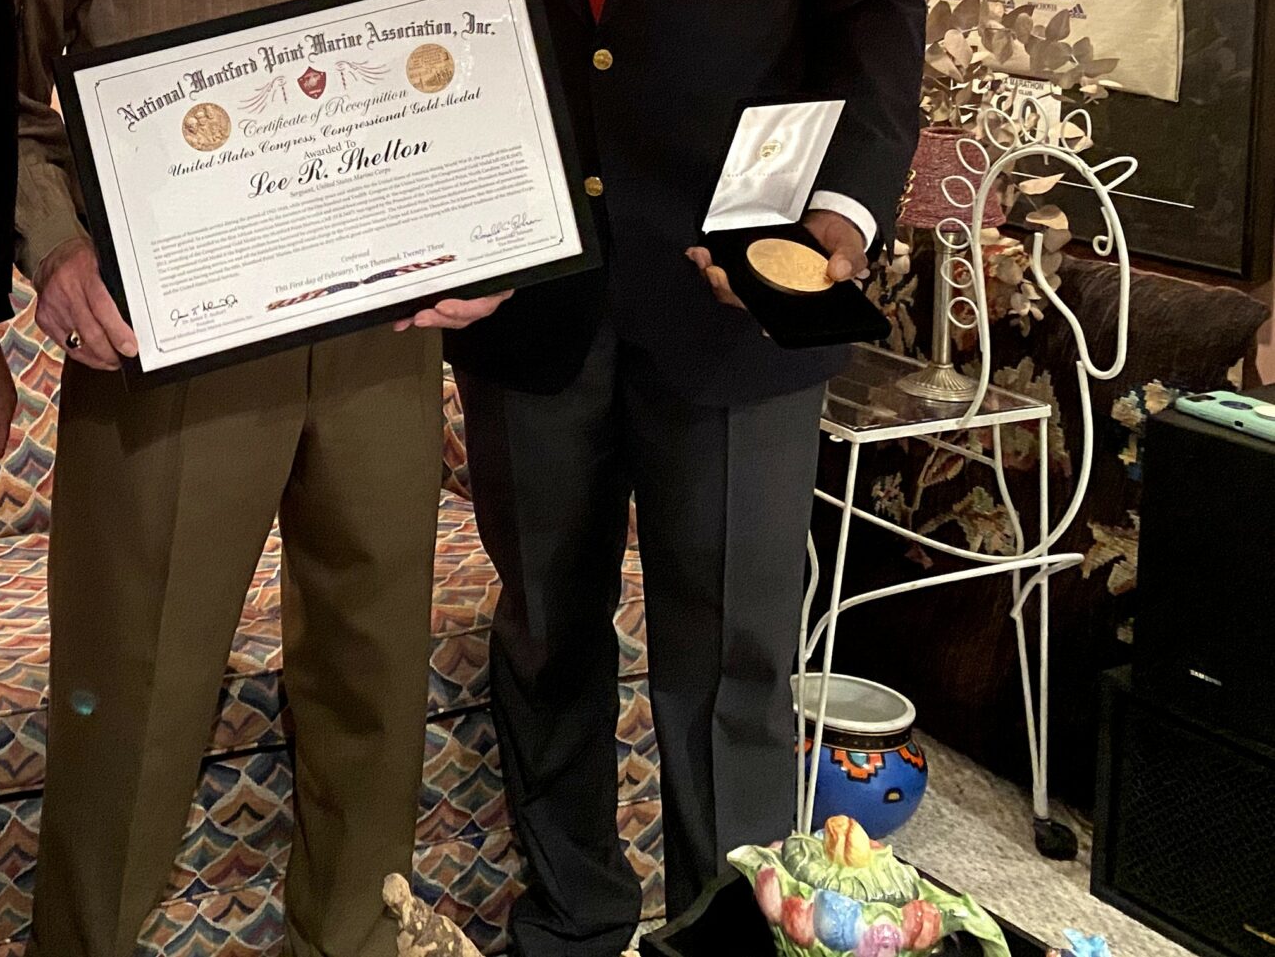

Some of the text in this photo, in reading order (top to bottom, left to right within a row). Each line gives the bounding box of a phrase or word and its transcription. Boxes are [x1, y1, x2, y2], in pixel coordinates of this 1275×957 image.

[117, 11, 496, 133] National Montford Point Marine Association, Inc.
[168, 87, 482, 177] United States Congress, Congressional Gold Medal
[238, 89, 408, 138] Certificate of Recognition
[248, 170, 292, 199] Lee
[298, 158, 328, 185] R.
[337, 138, 433, 175] Shelton
[303, 139, 357, 160] Awarded To
[316, 180, 336, 192] United
[336, 176, 354, 188] States
[353, 171, 375, 183] Marine
[375, 167, 391, 178] Corps
[275, 284, 289, 294] This
[289, 280, 304, 291] First
[305, 276, 318, 288] day
[325, 267, 354, 282] February,
[355, 262, 369, 272] Two
[370, 253, 402, 269] Thousand,
